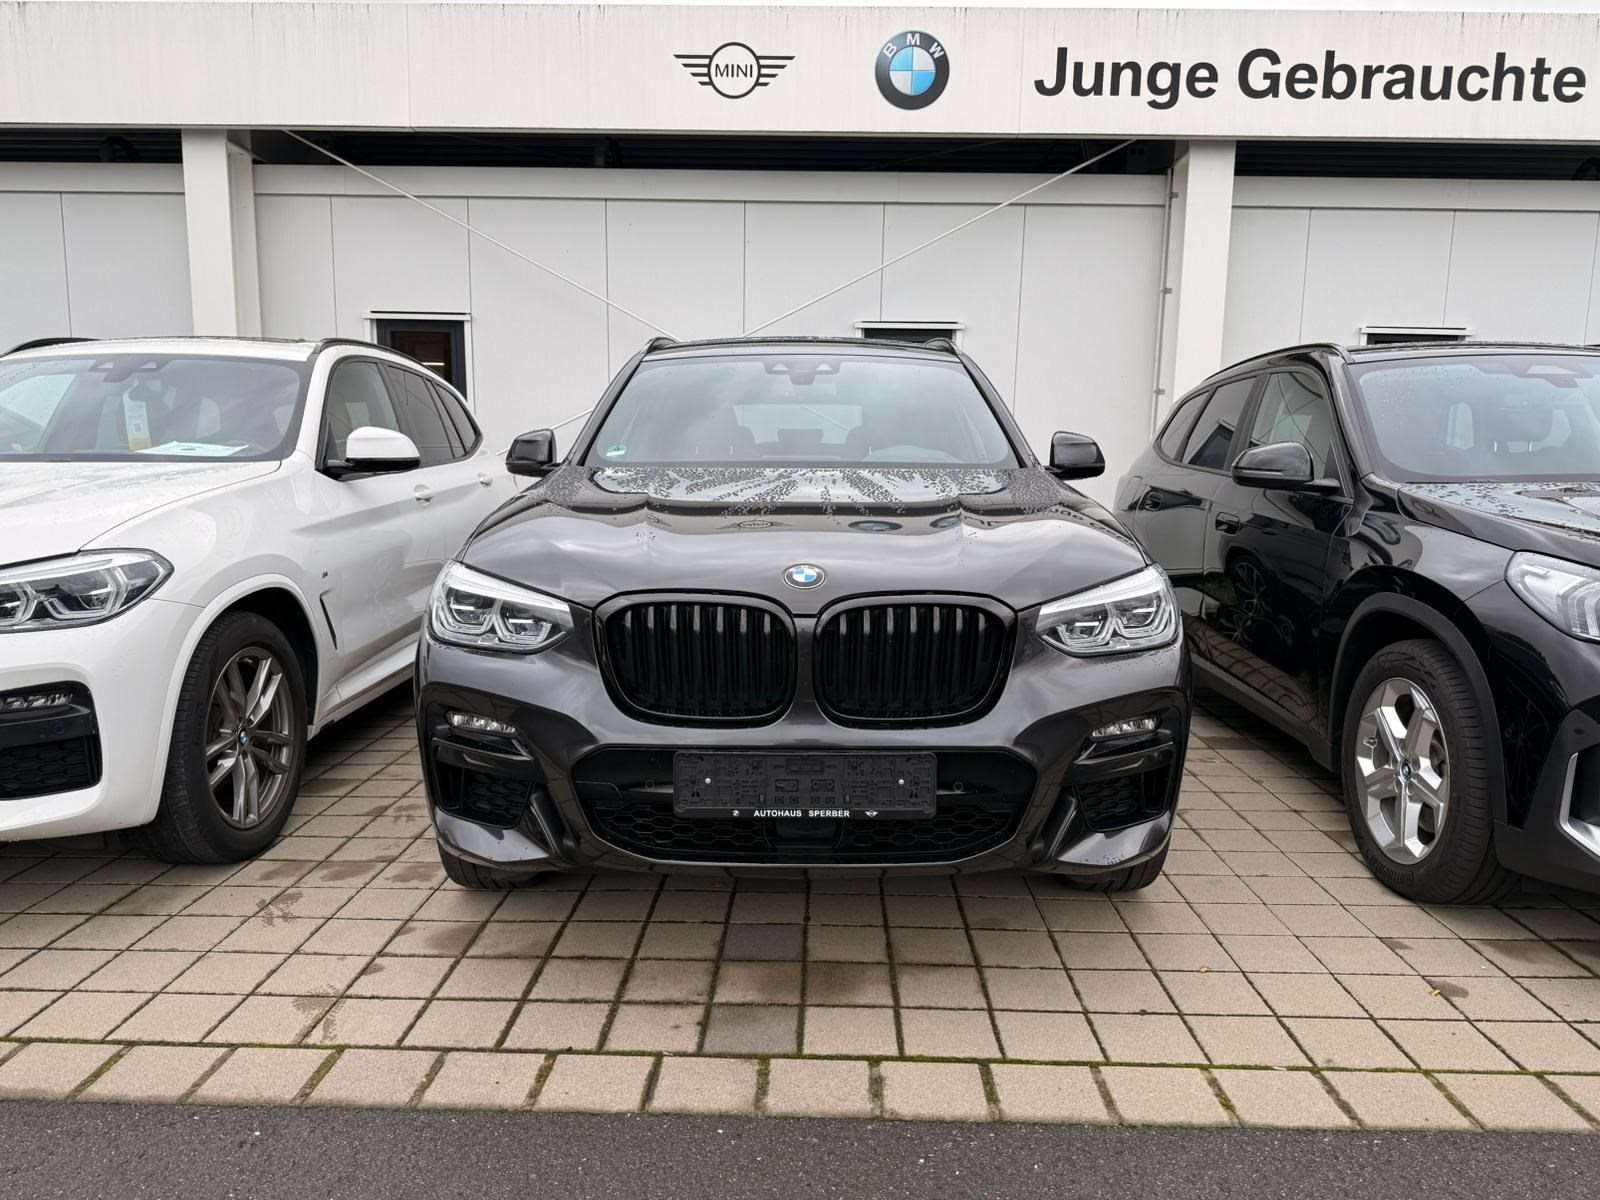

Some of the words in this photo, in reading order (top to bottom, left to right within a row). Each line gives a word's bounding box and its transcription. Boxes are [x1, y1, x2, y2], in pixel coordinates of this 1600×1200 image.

[883, 31, 945, 59] BMW
[714, 63, 754, 78] MINI
[1034, 47, 1219, 110] Junge
[1237, 48, 1586, 103] Gebrauchte
[753, 809, 802, 817] AUTOHAUS
[808, 809, 850, 817] SPERBER
